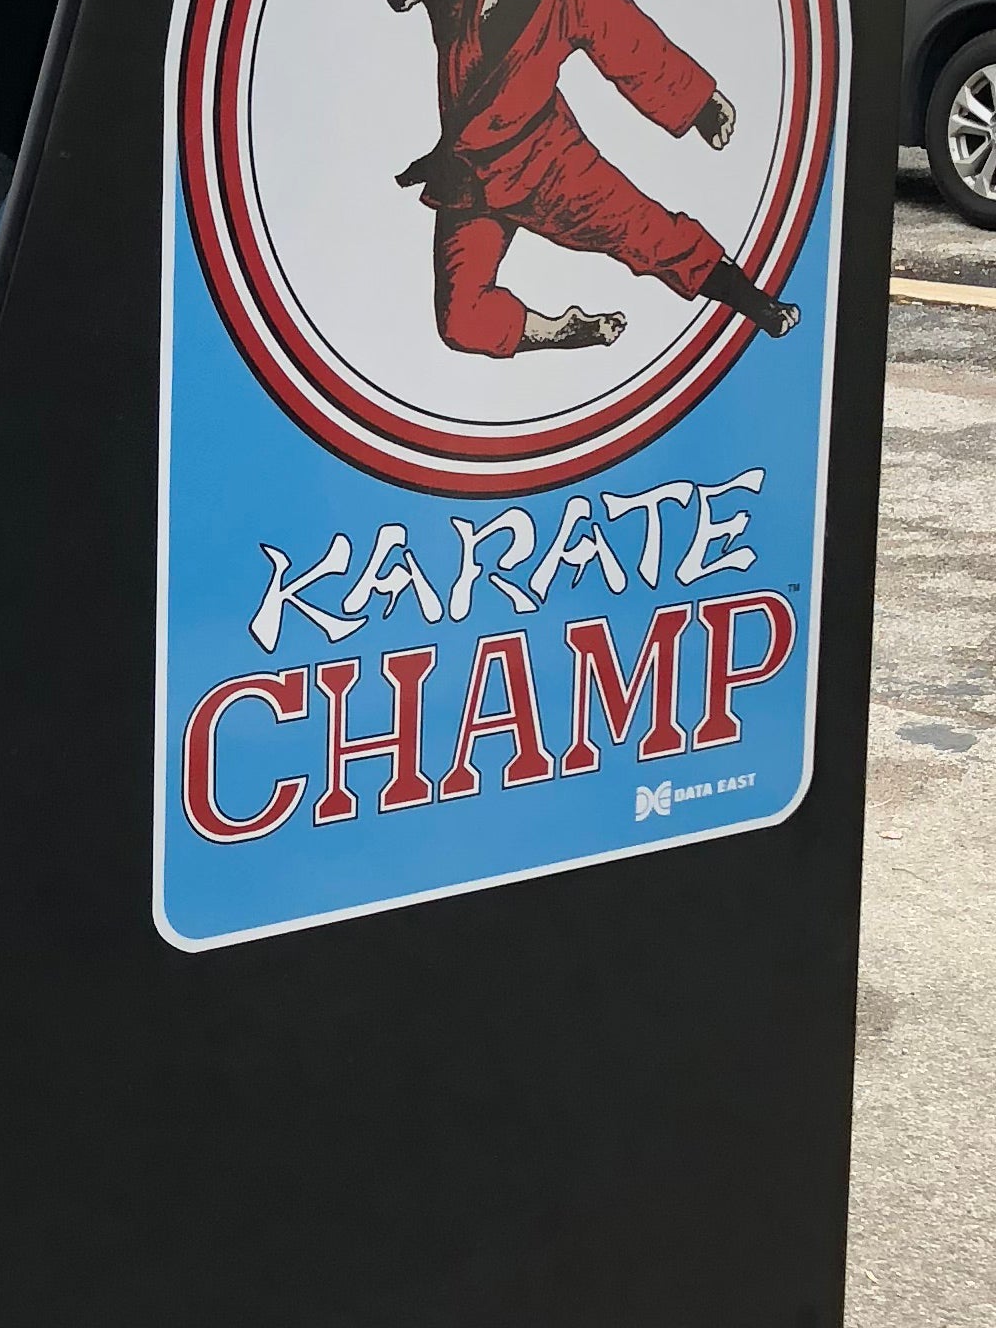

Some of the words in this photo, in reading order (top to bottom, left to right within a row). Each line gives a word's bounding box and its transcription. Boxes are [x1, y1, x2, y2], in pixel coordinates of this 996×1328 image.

[248, 466, 766, 654] KARATE
[181, 589, 798, 845] CHAMP
[674, 782, 713, 802] DATA
[717, 772, 756, 793] EAST
